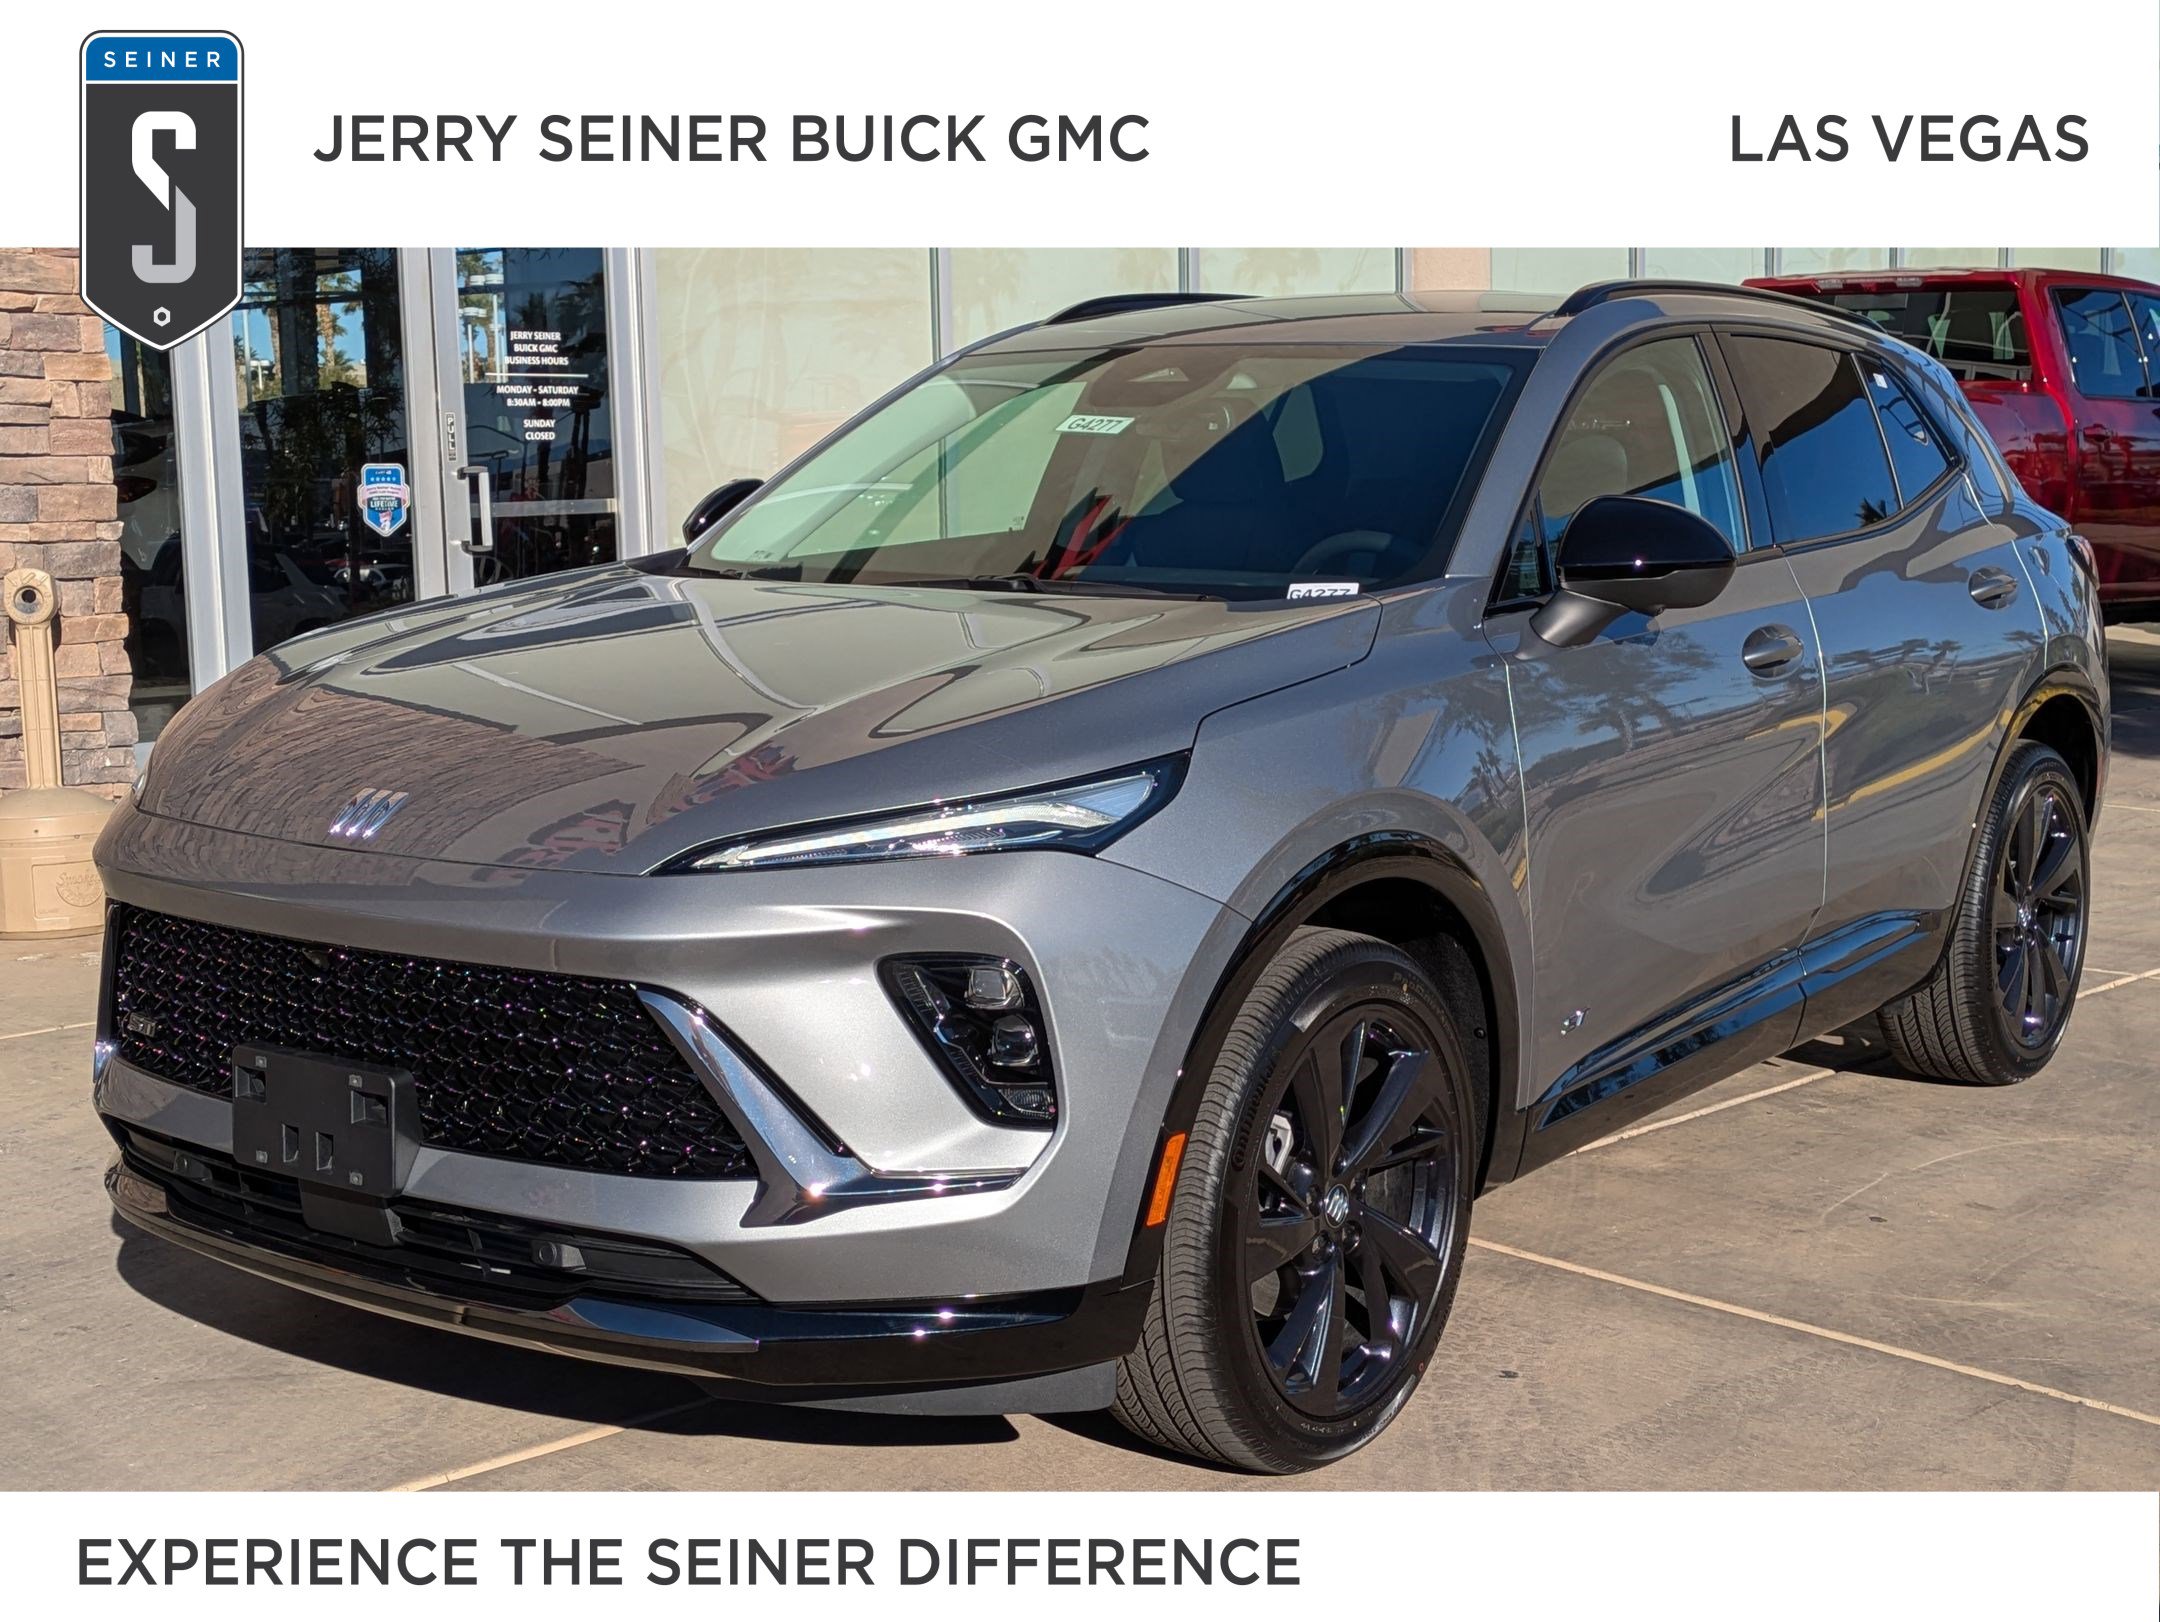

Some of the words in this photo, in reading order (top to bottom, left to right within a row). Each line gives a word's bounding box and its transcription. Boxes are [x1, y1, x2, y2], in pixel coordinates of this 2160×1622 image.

[510, 331, 533, 341] JERRY
[534, 331, 562, 341] SEINER
[513, 343, 538, 353] BUICK
[539, 344, 558, 353] GMC
[504, 356, 540, 365] BUSINESS
[541, 357, 569, 366] HOURS
[496, 385, 532, 394] MONDAY
[538, 385, 579, 395] SATURDAY
[506, 398, 536, 407] 8:30AM
[542, 398, 571, 407] 8:00PM
[523, 419, 556, 428] SUNDAY
[1067, 417, 1124, 432] G4277
[447, 417, 455, 450] PULL
[525, 431, 556, 441] CLOSED
[370, 500, 398, 508] LIFETIME
